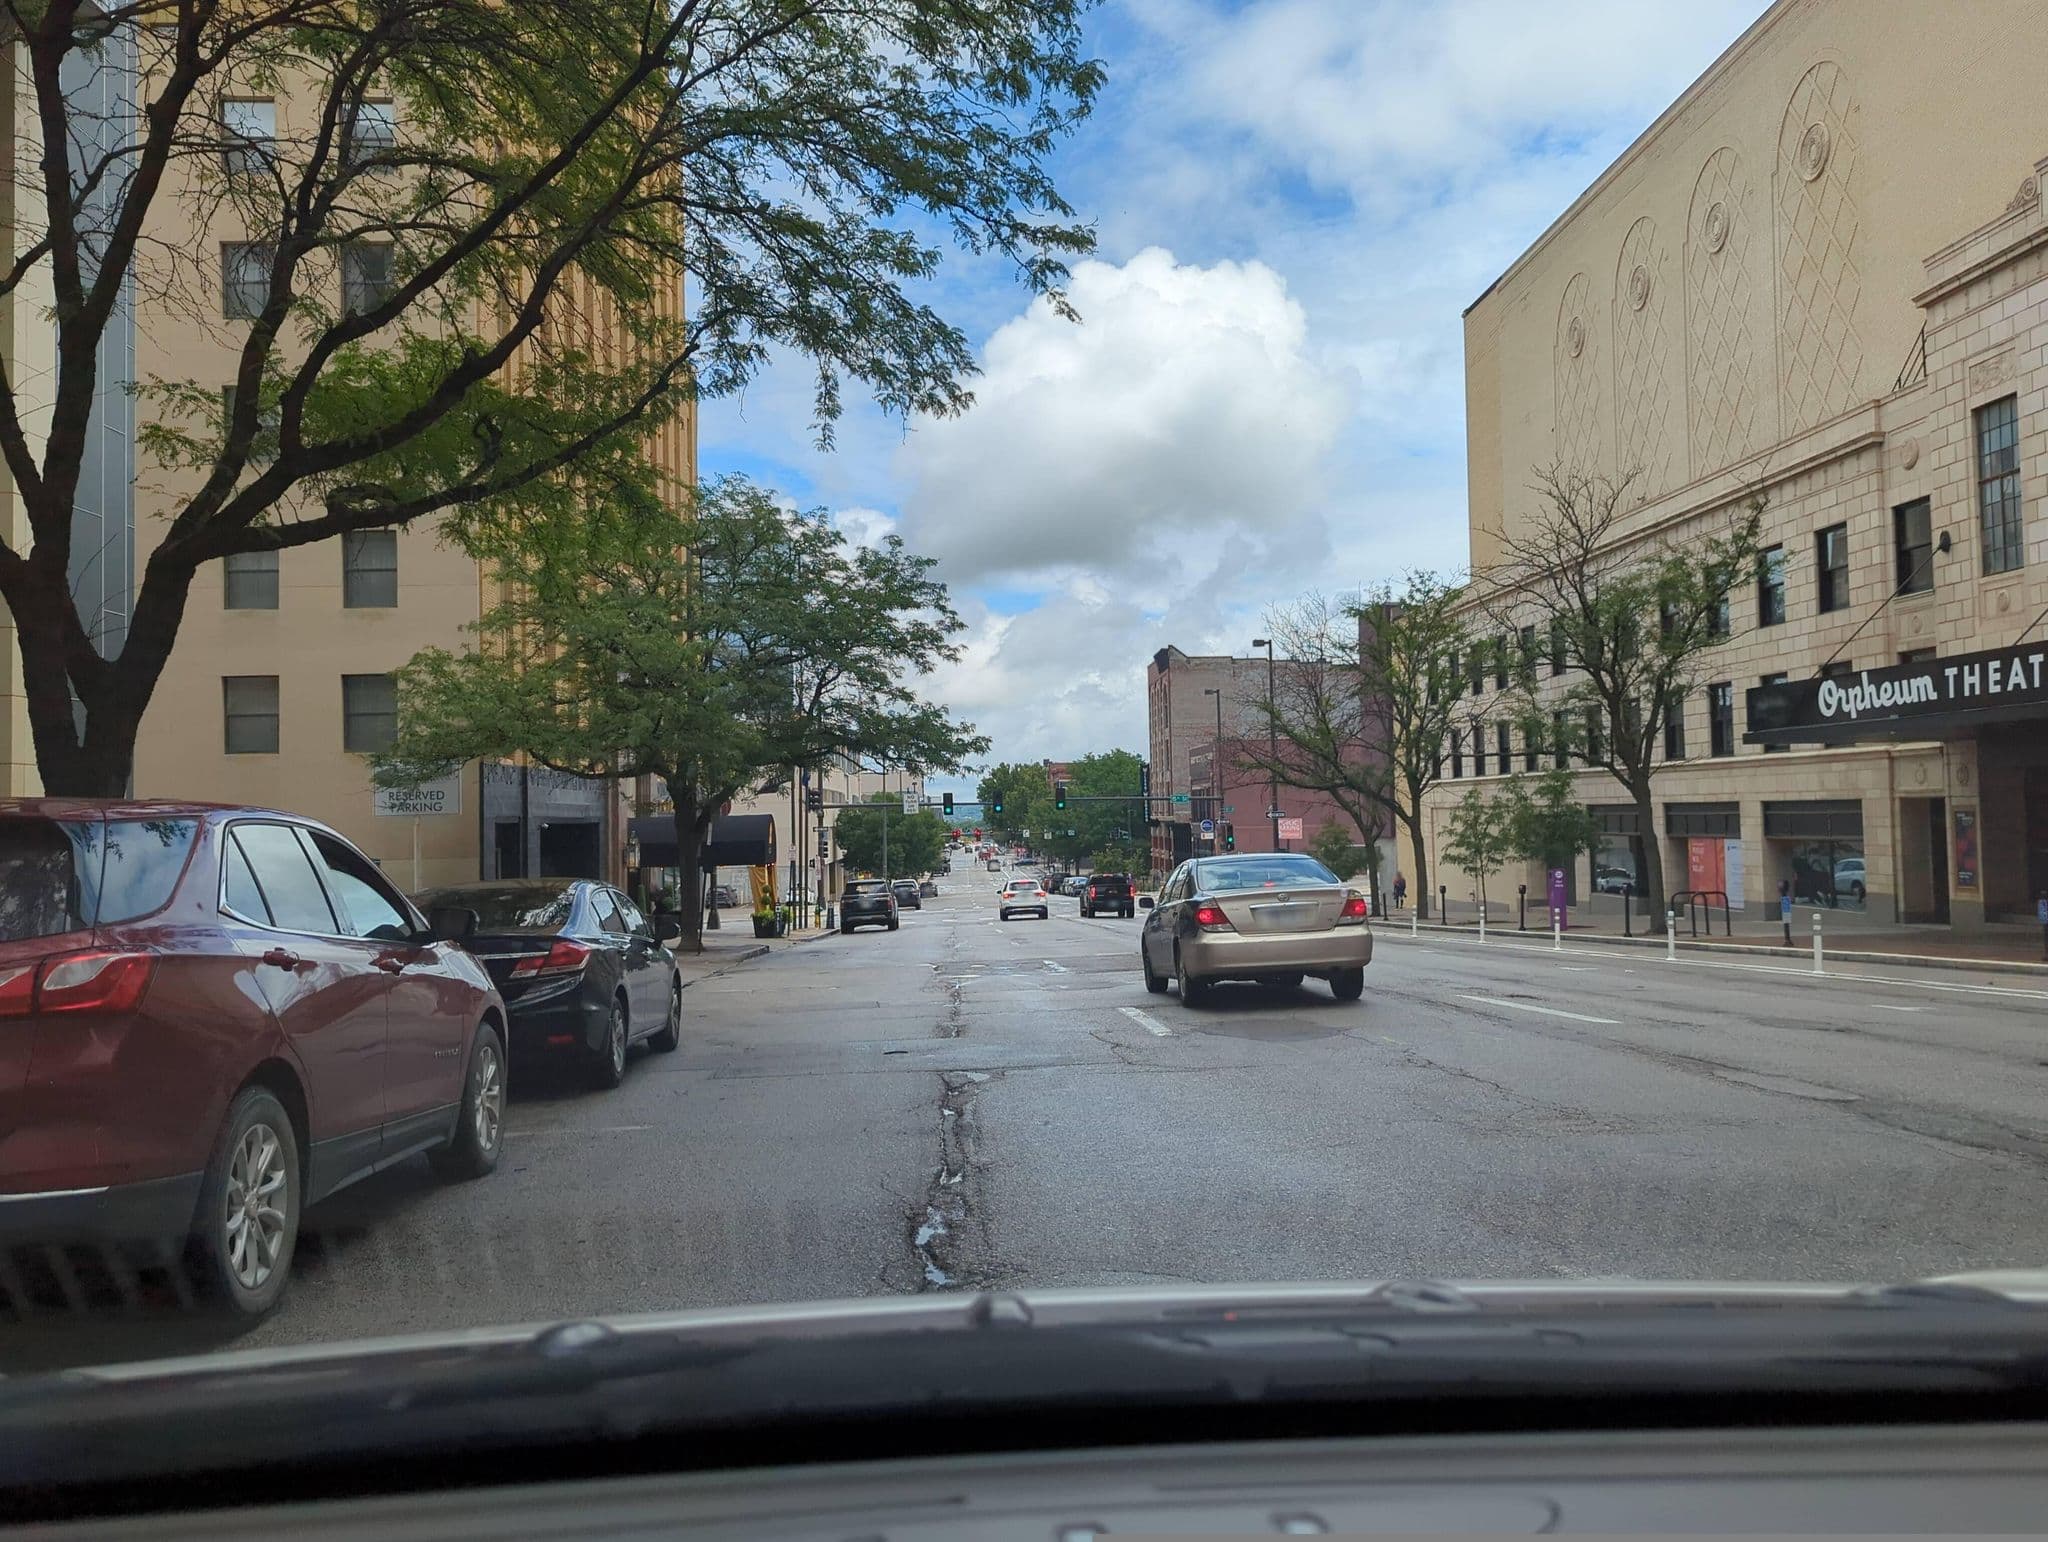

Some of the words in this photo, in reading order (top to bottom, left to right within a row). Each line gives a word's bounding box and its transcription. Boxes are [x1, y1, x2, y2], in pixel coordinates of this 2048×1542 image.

[1818, 671, 1938, 719] Orpheum
[1945, 653, 2044, 699] THEAT
[388, 790, 445, 801] RESERVED
[390, 802, 443, 812] PARKING
